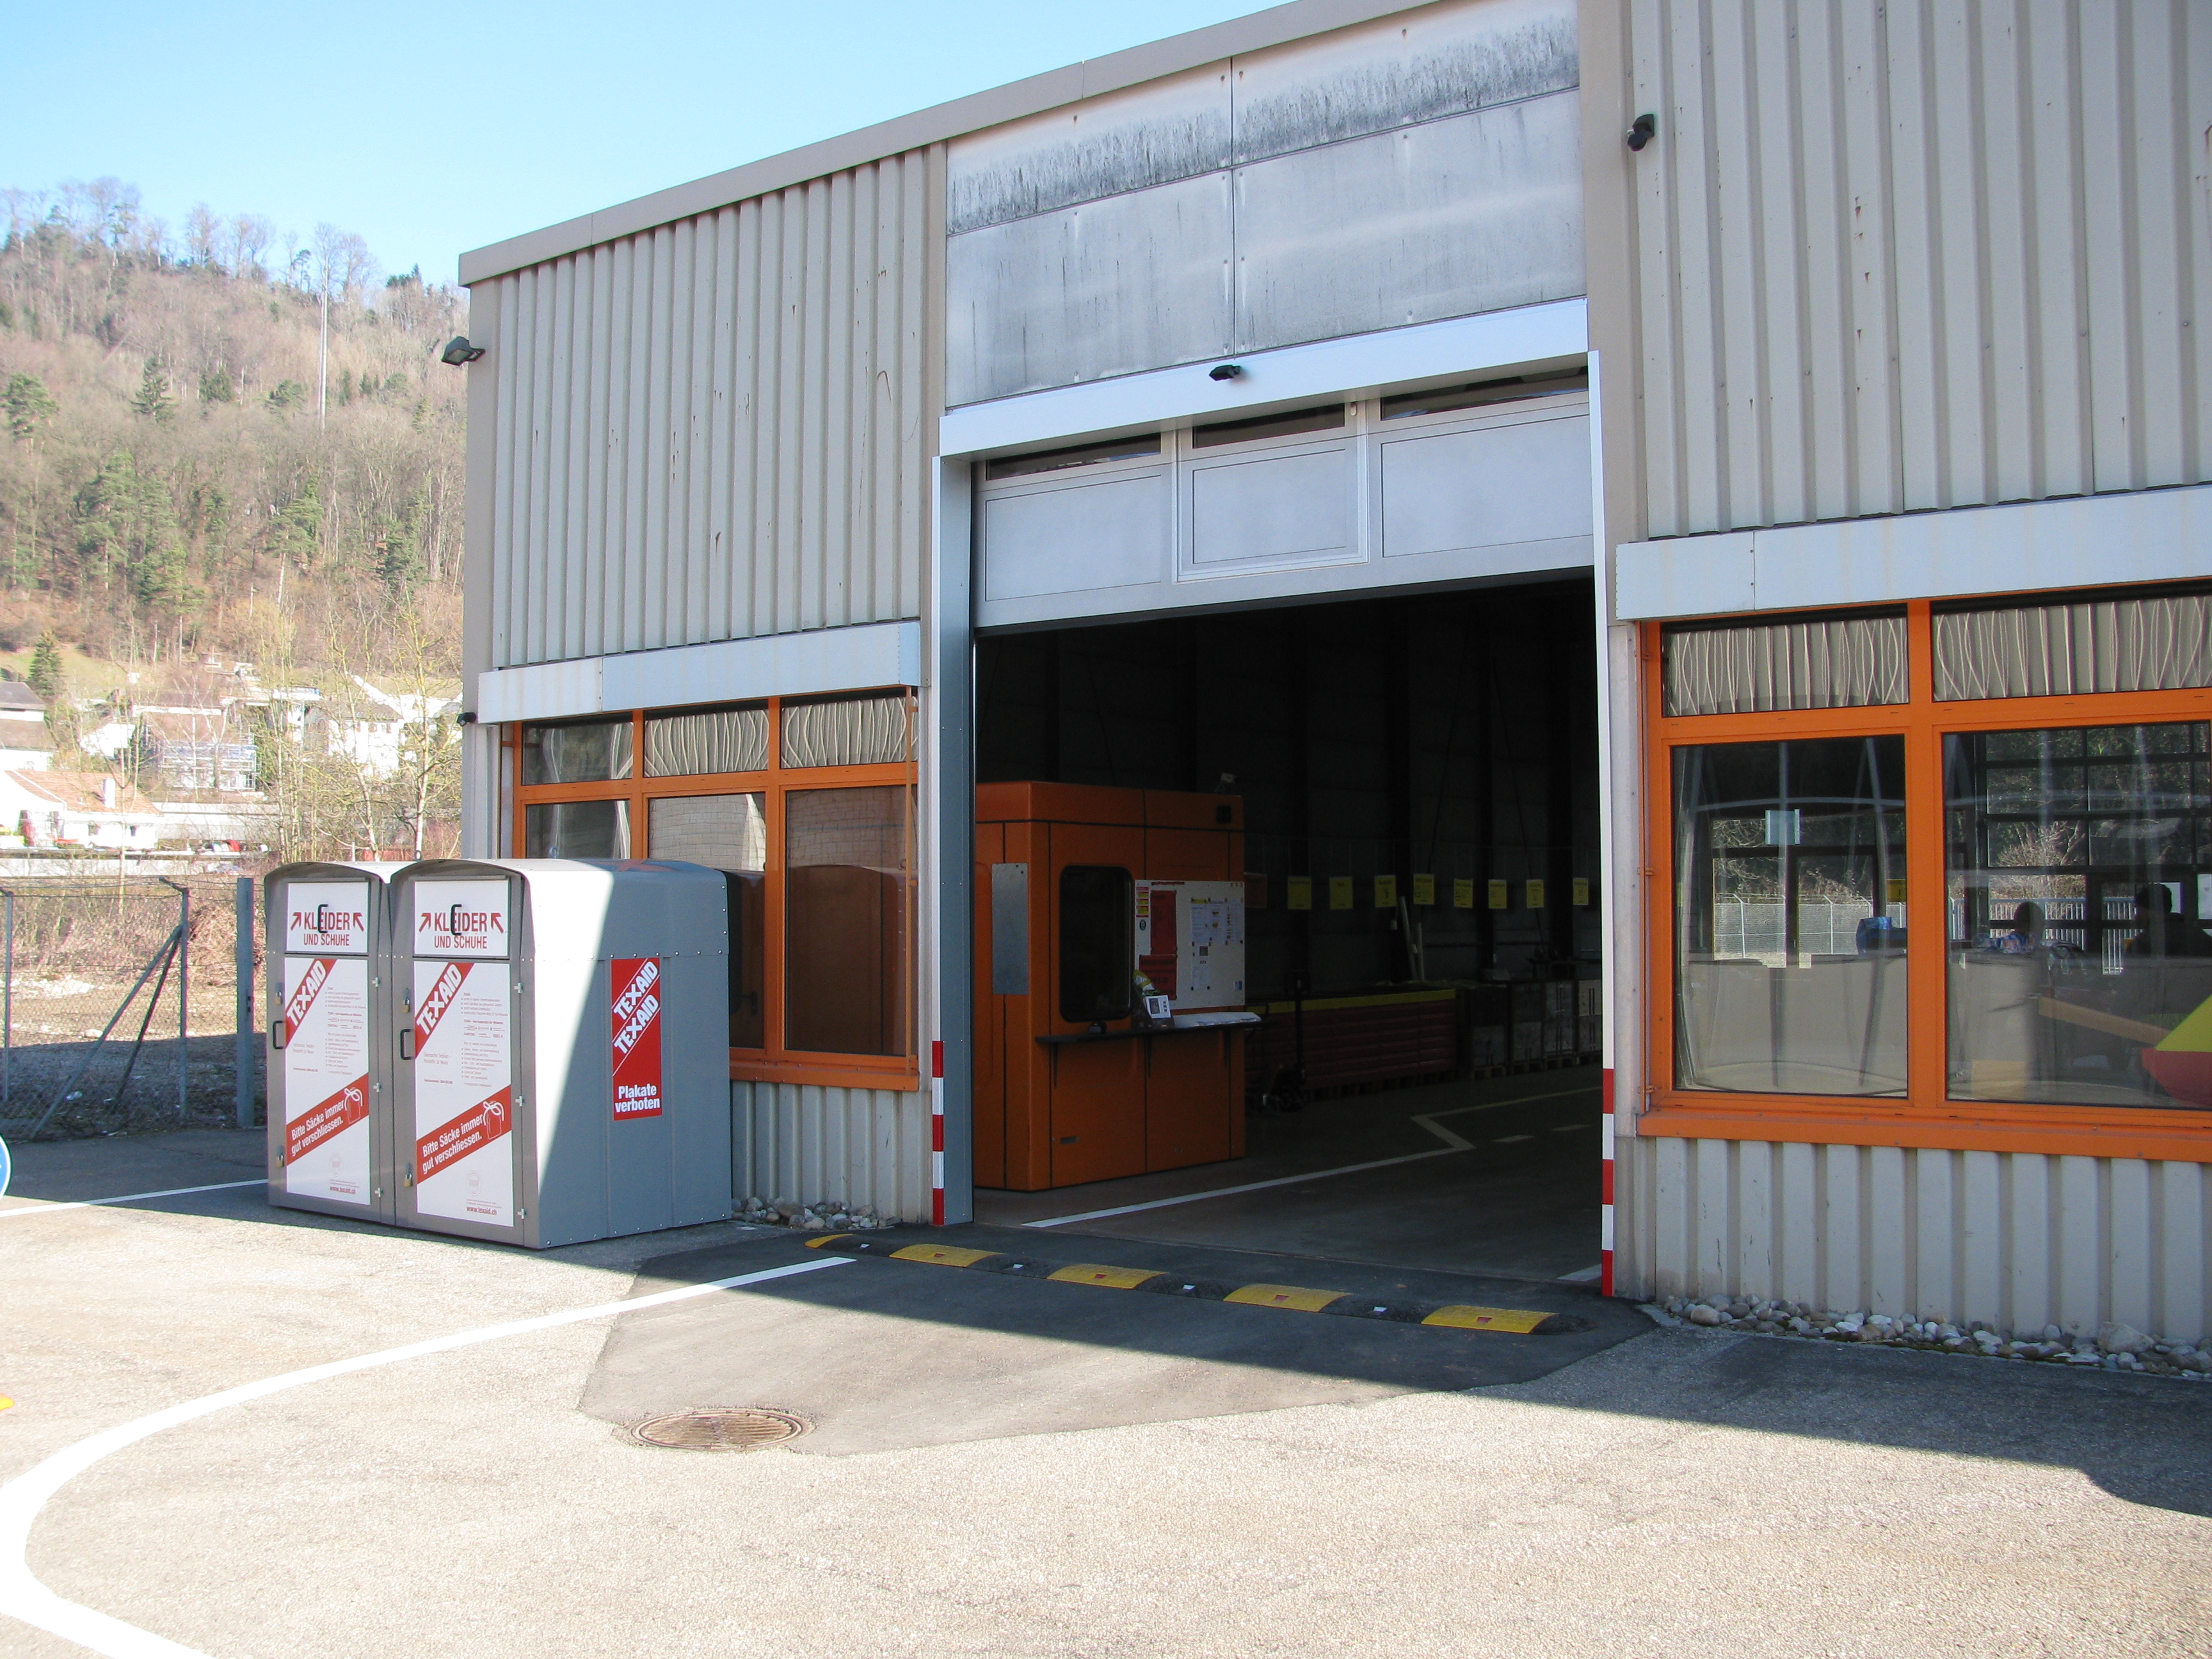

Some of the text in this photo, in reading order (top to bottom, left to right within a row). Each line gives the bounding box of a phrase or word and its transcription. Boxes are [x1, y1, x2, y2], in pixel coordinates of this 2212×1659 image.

[303, 933, 350, 946] UND SCHUHE
[434, 935, 488, 949] UND SCHUHE
[286, 959, 326, 1027] TEXAID
[416, 963, 463, 1036] TEXAID
[613, 961, 659, 1021] TEXAID
[613, 993, 659, 1055] TEXAID
[614, 1096, 661, 1113] verboten
[618, 1083, 657, 1100] Plakate
[291, 1099, 345, 1141] Bitte Säcke immer
[291, 1116, 344, 1157] gut verschliessen.
[422, 1113, 485, 1158] Bitte Säcke immer
[422, 1130, 483, 1175] gut verschliessen.
